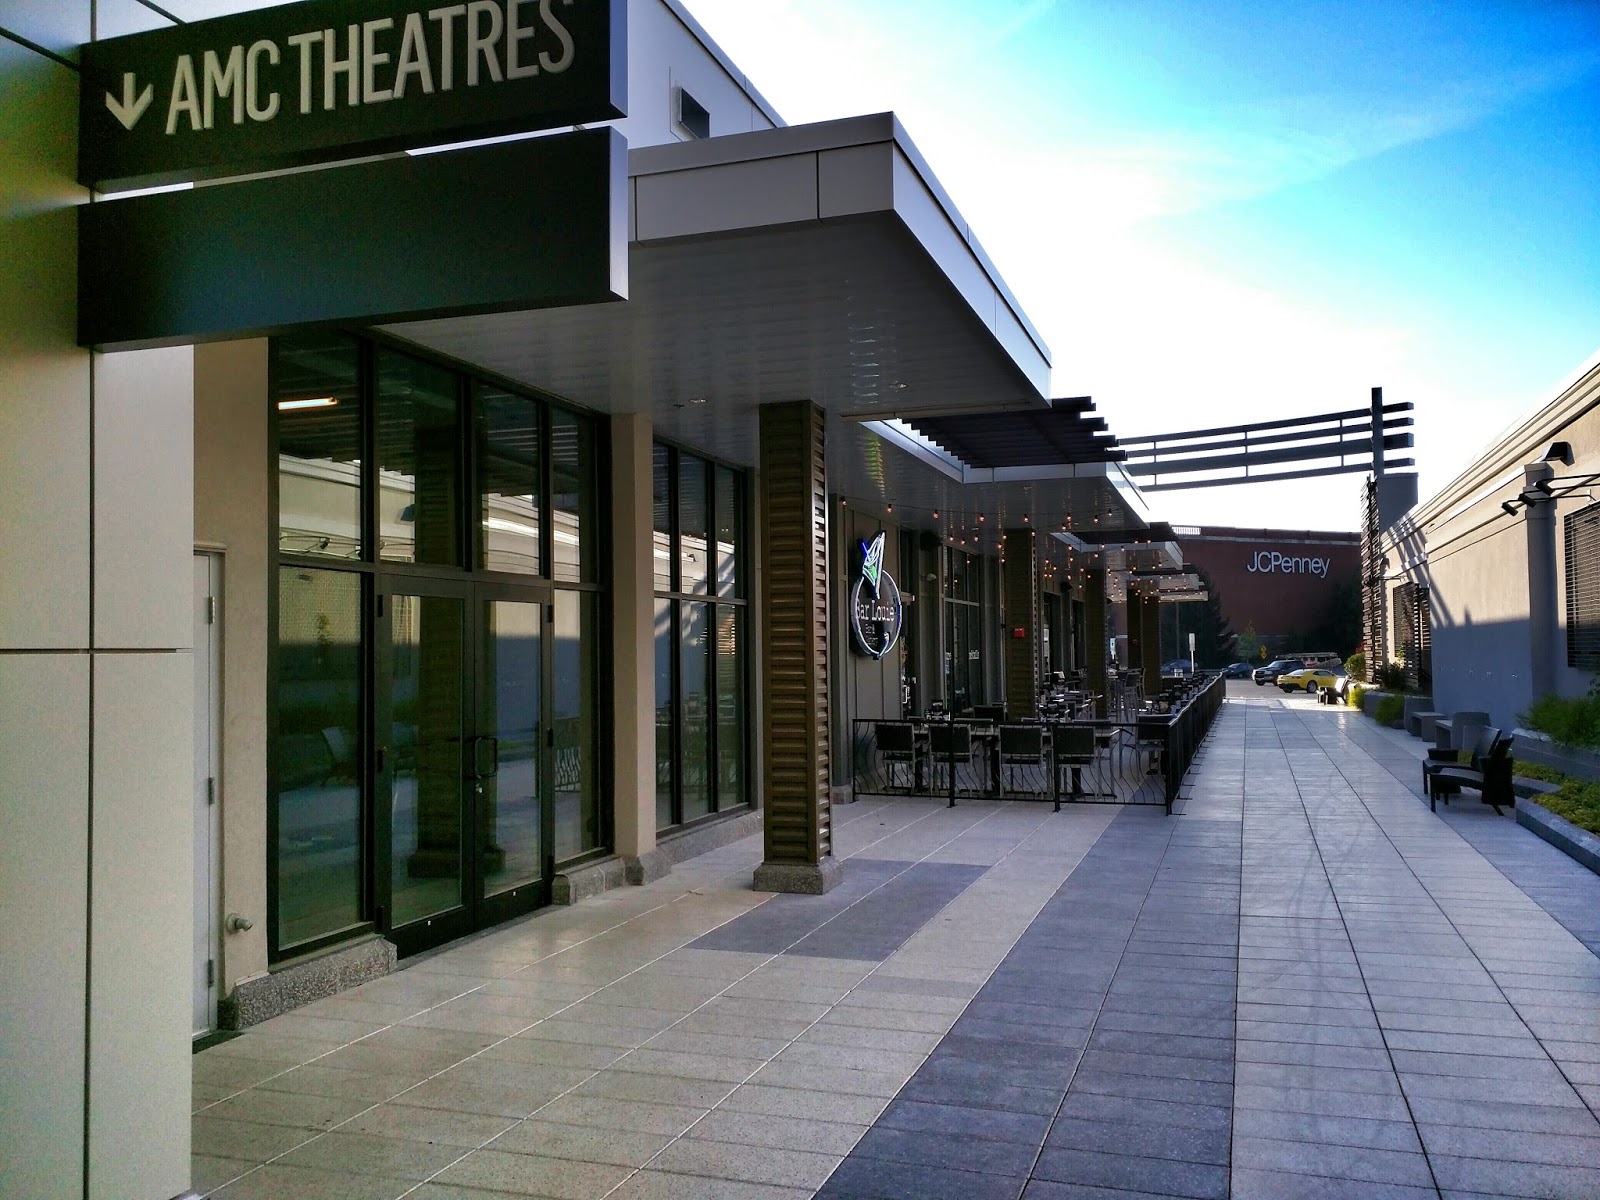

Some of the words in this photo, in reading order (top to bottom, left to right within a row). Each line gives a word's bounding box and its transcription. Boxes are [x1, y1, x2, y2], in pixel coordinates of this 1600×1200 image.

[165, 39, 280, 135] AMC
[287, 0, 576, 114] THEATRES
[1247, 551, 1331, 578] JCPenney
[871, 600, 895, 621] Louie
